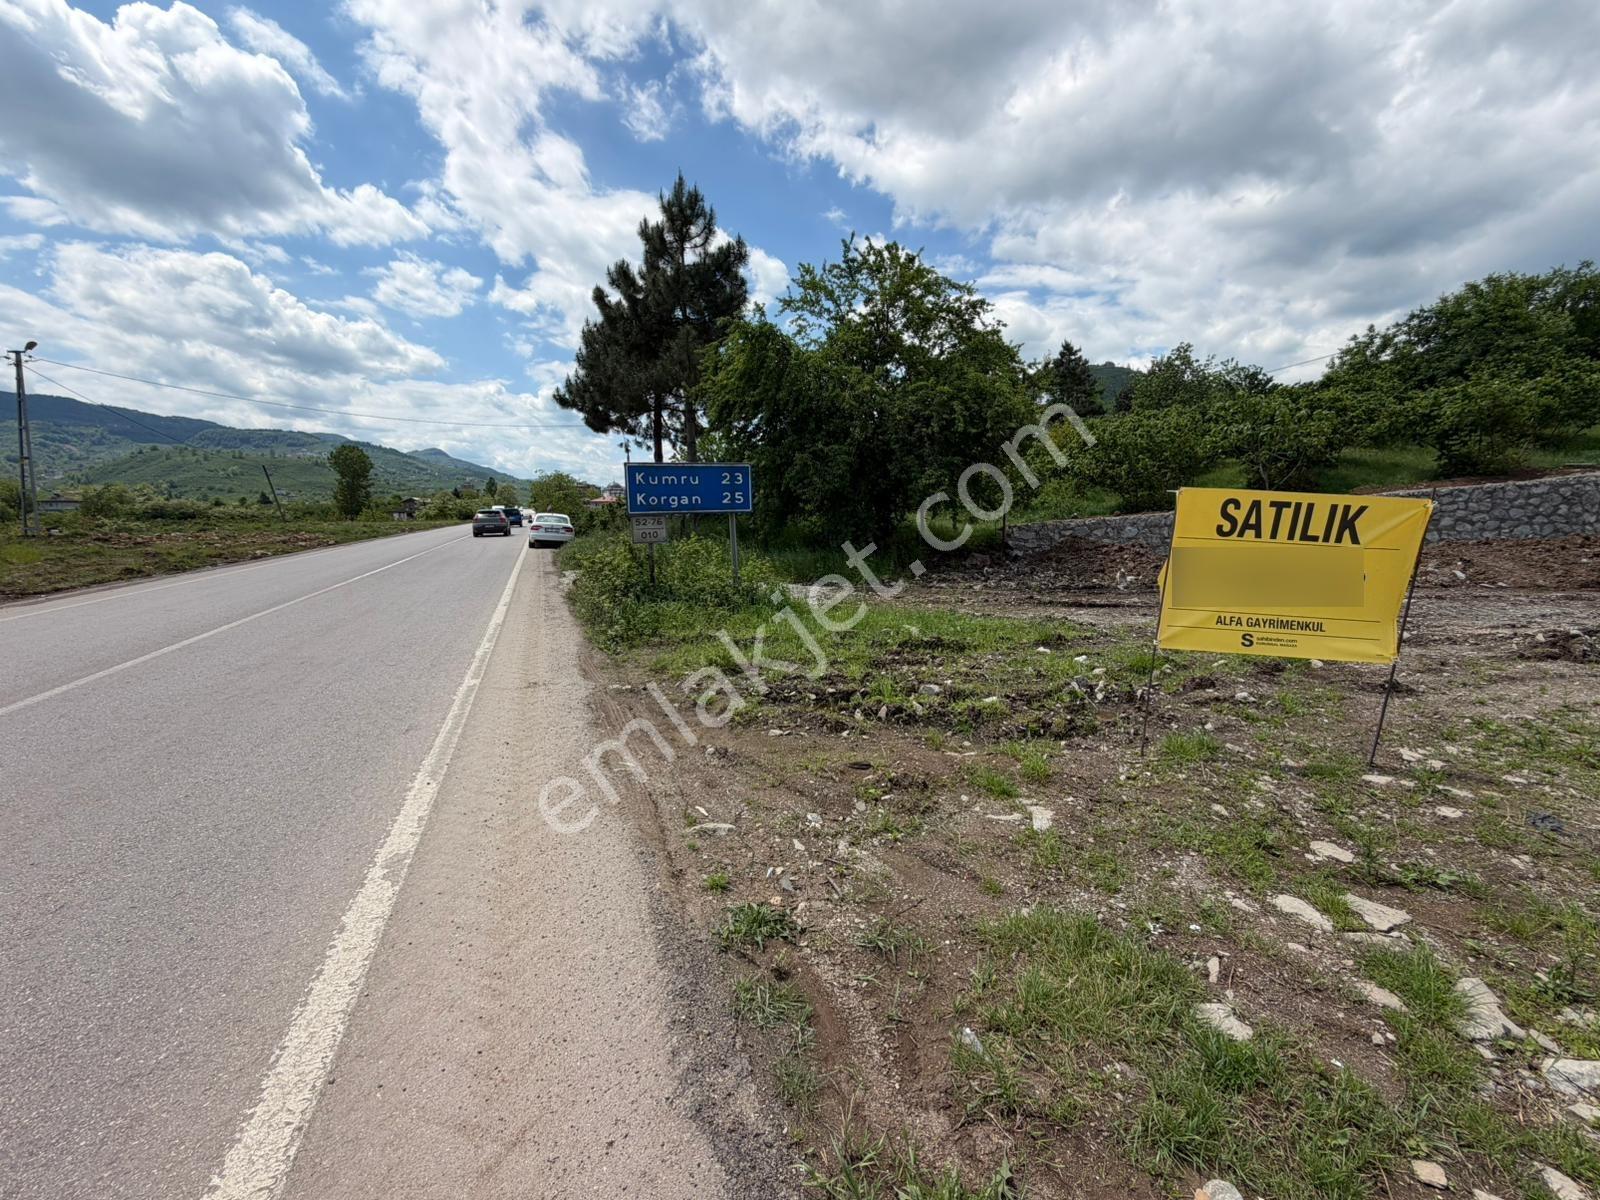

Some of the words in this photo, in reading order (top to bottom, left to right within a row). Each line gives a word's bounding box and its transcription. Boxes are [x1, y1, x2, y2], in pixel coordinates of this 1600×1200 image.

[635, 472, 699, 484] Kumru
[721, 473, 743, 484] 23
[636, 493, 701, 508] Korgan
[722, 492, 744, 503] 25
[1215, 498, 1369, 545] SATILIK
[640, 531, 659, 539] 010
[1215, 615, 1243, 627] ALFA
[1246, 617, 1326, 632] GAYRİMENKUL
